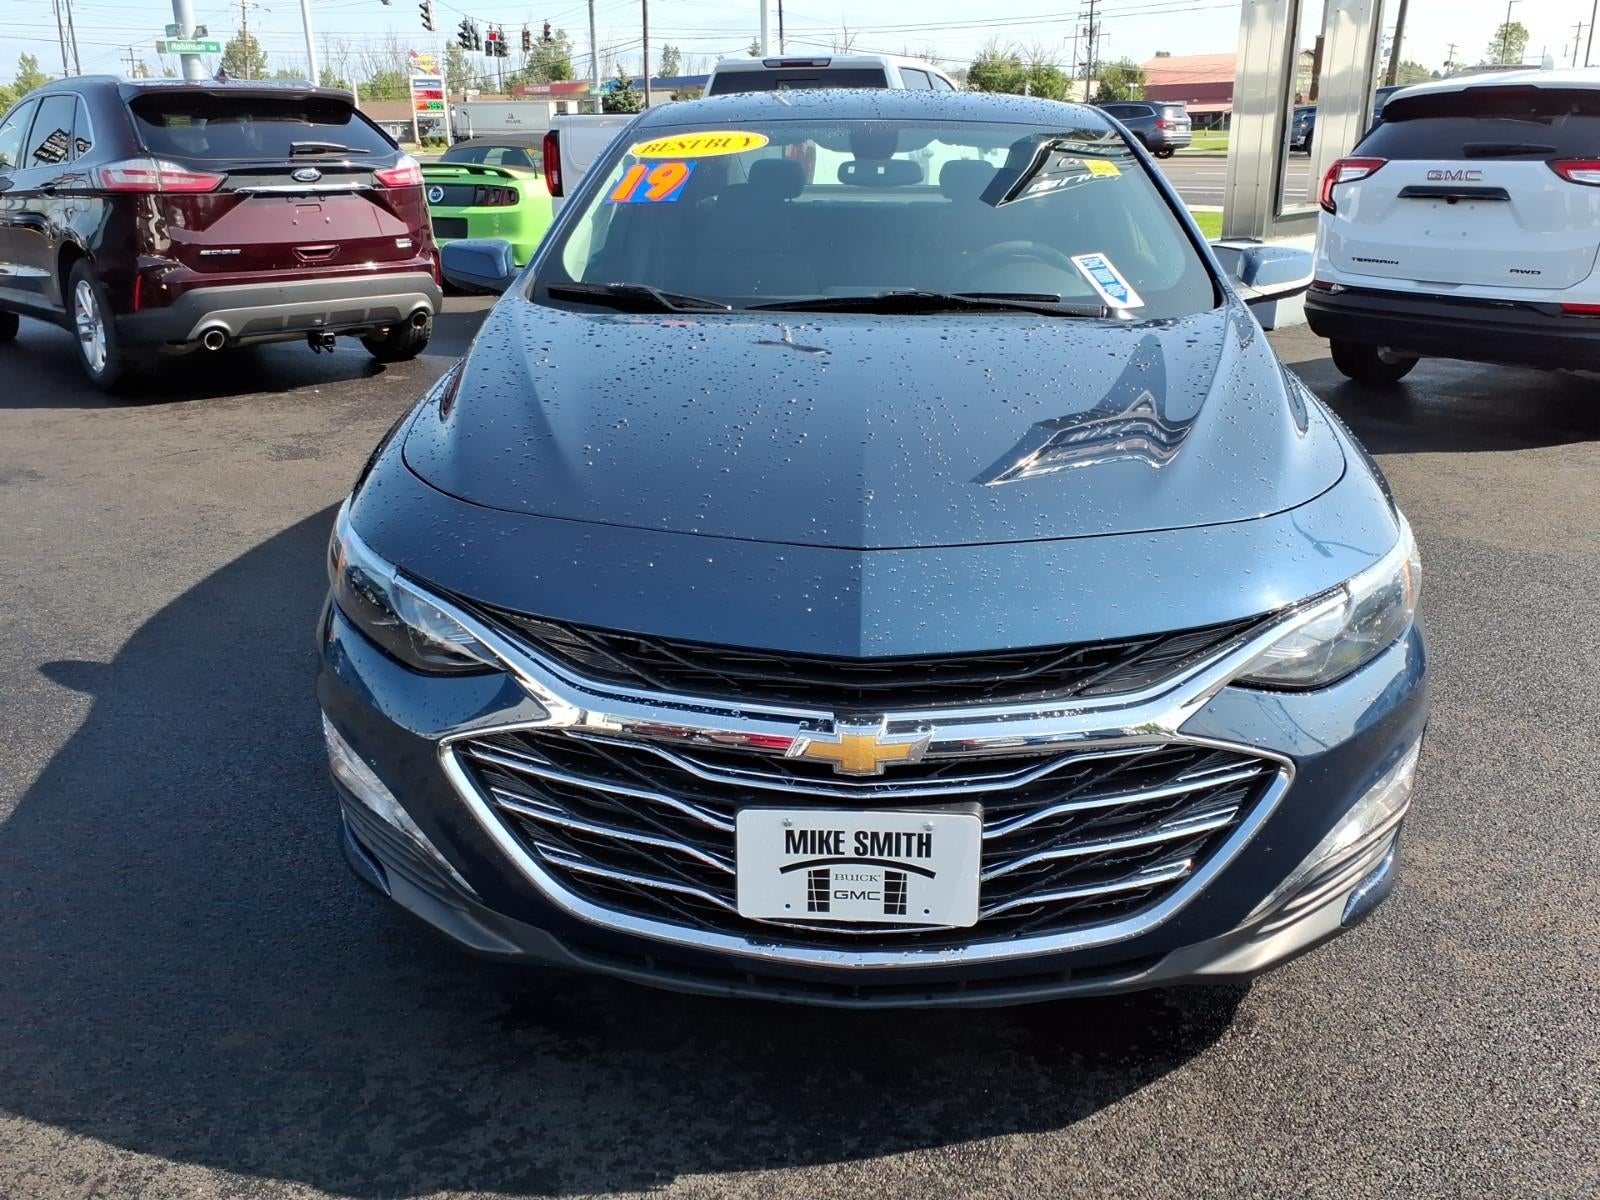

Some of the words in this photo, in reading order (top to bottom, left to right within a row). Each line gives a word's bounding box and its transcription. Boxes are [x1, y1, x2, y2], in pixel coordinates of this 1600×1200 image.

[171, 42, 206, 51] Robinson
[1427, 170, 1482, 181] GMC
[610, 162, 690, 203] 19
[200, 248, 242, 256] EDGE
[1351, 257, 1399, 265] TERRAIN
[785, 829, 846, 856] MIKE
[854, 830, 932, 858] SMITH
[833, 873, 881, 882] BUICK
[833, 890, 881, 901] GMC
